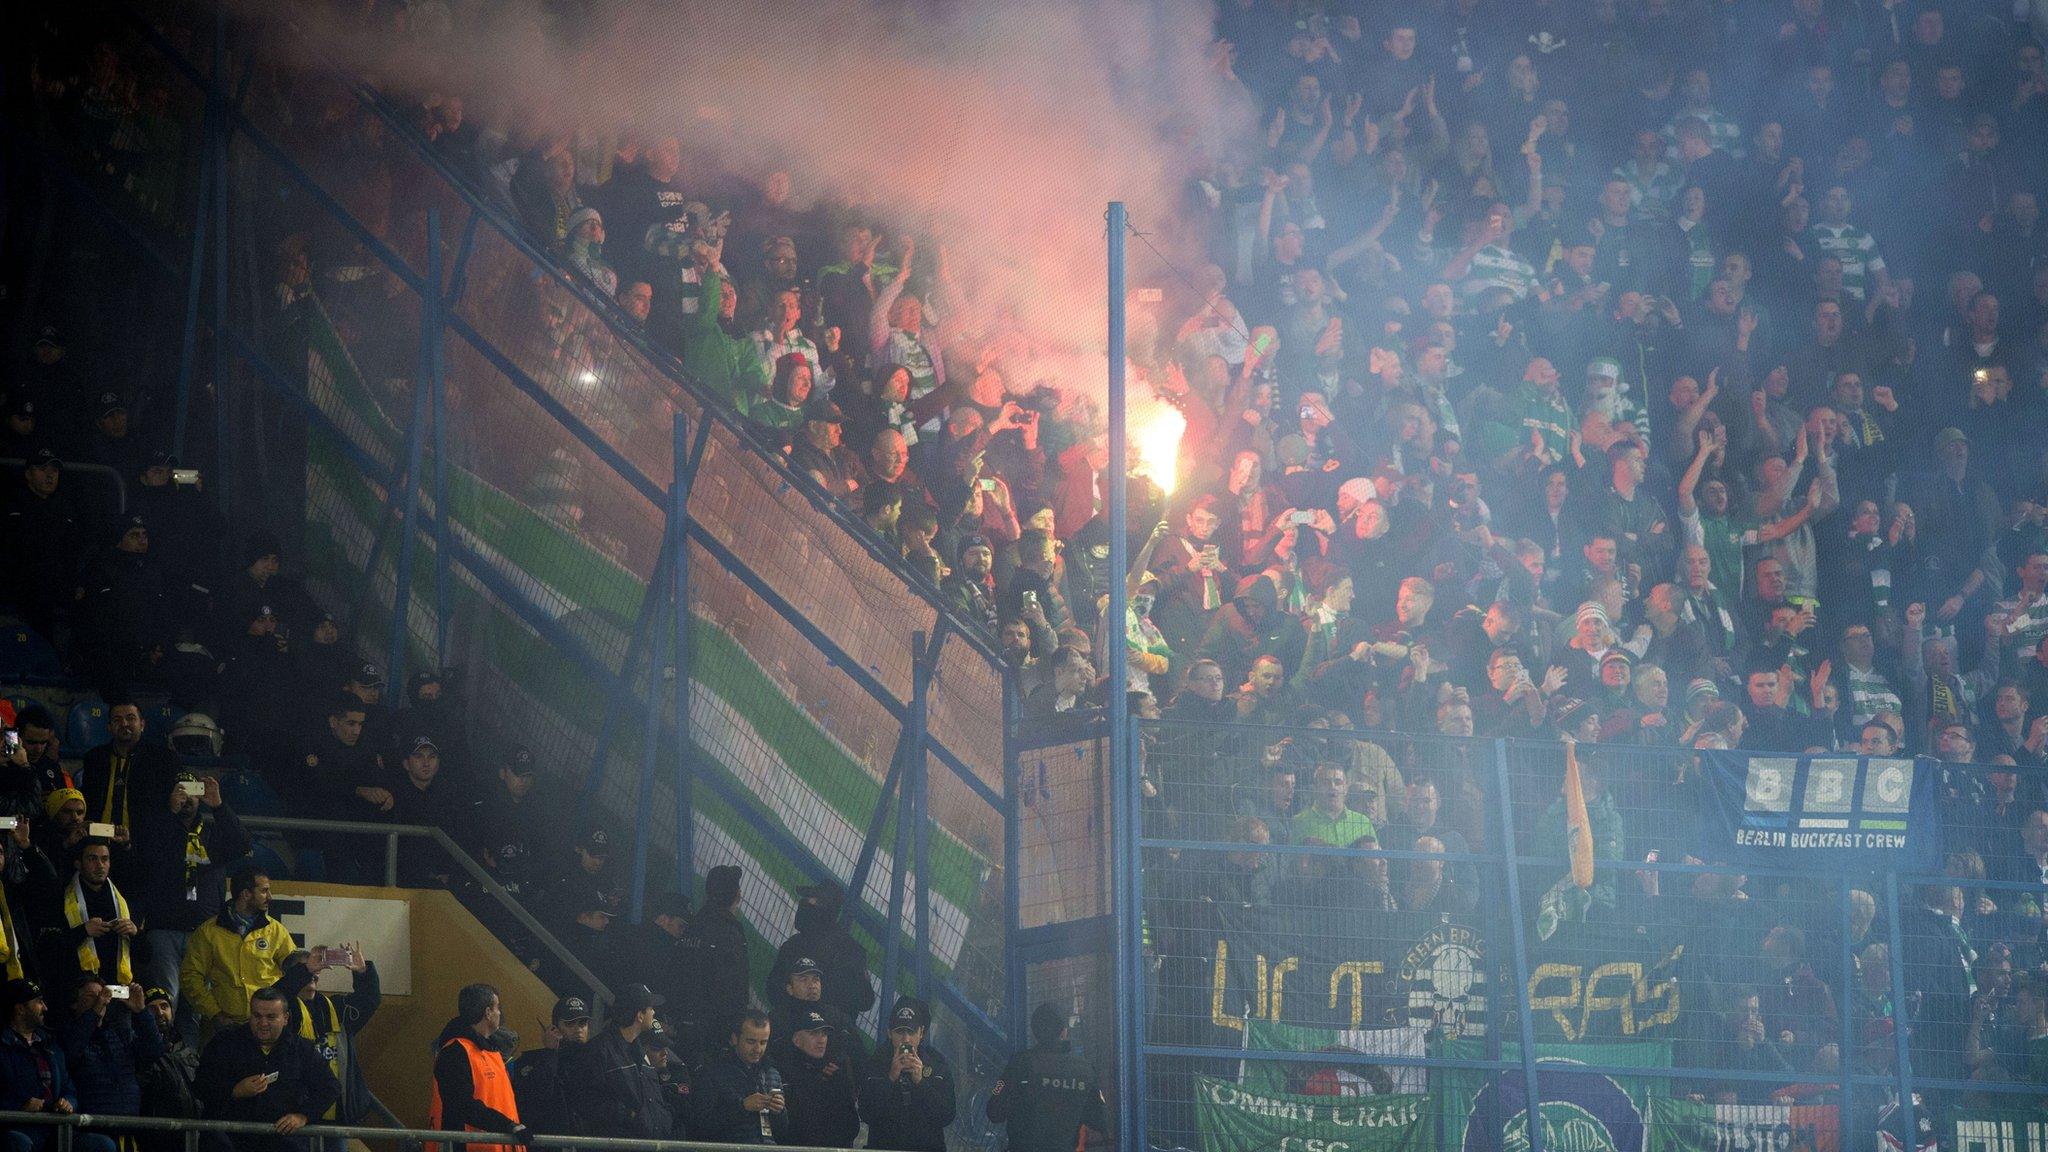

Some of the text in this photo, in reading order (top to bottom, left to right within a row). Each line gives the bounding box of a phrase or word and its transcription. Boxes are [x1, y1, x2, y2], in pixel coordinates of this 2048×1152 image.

[90, 707, 101, 717] 20
[161, 707, 171, 717] 21
[1736, 829, 1906, 848] BERLIN BUCKFAST CREW
[1210, 1084, 1315, 1122] OMMY
